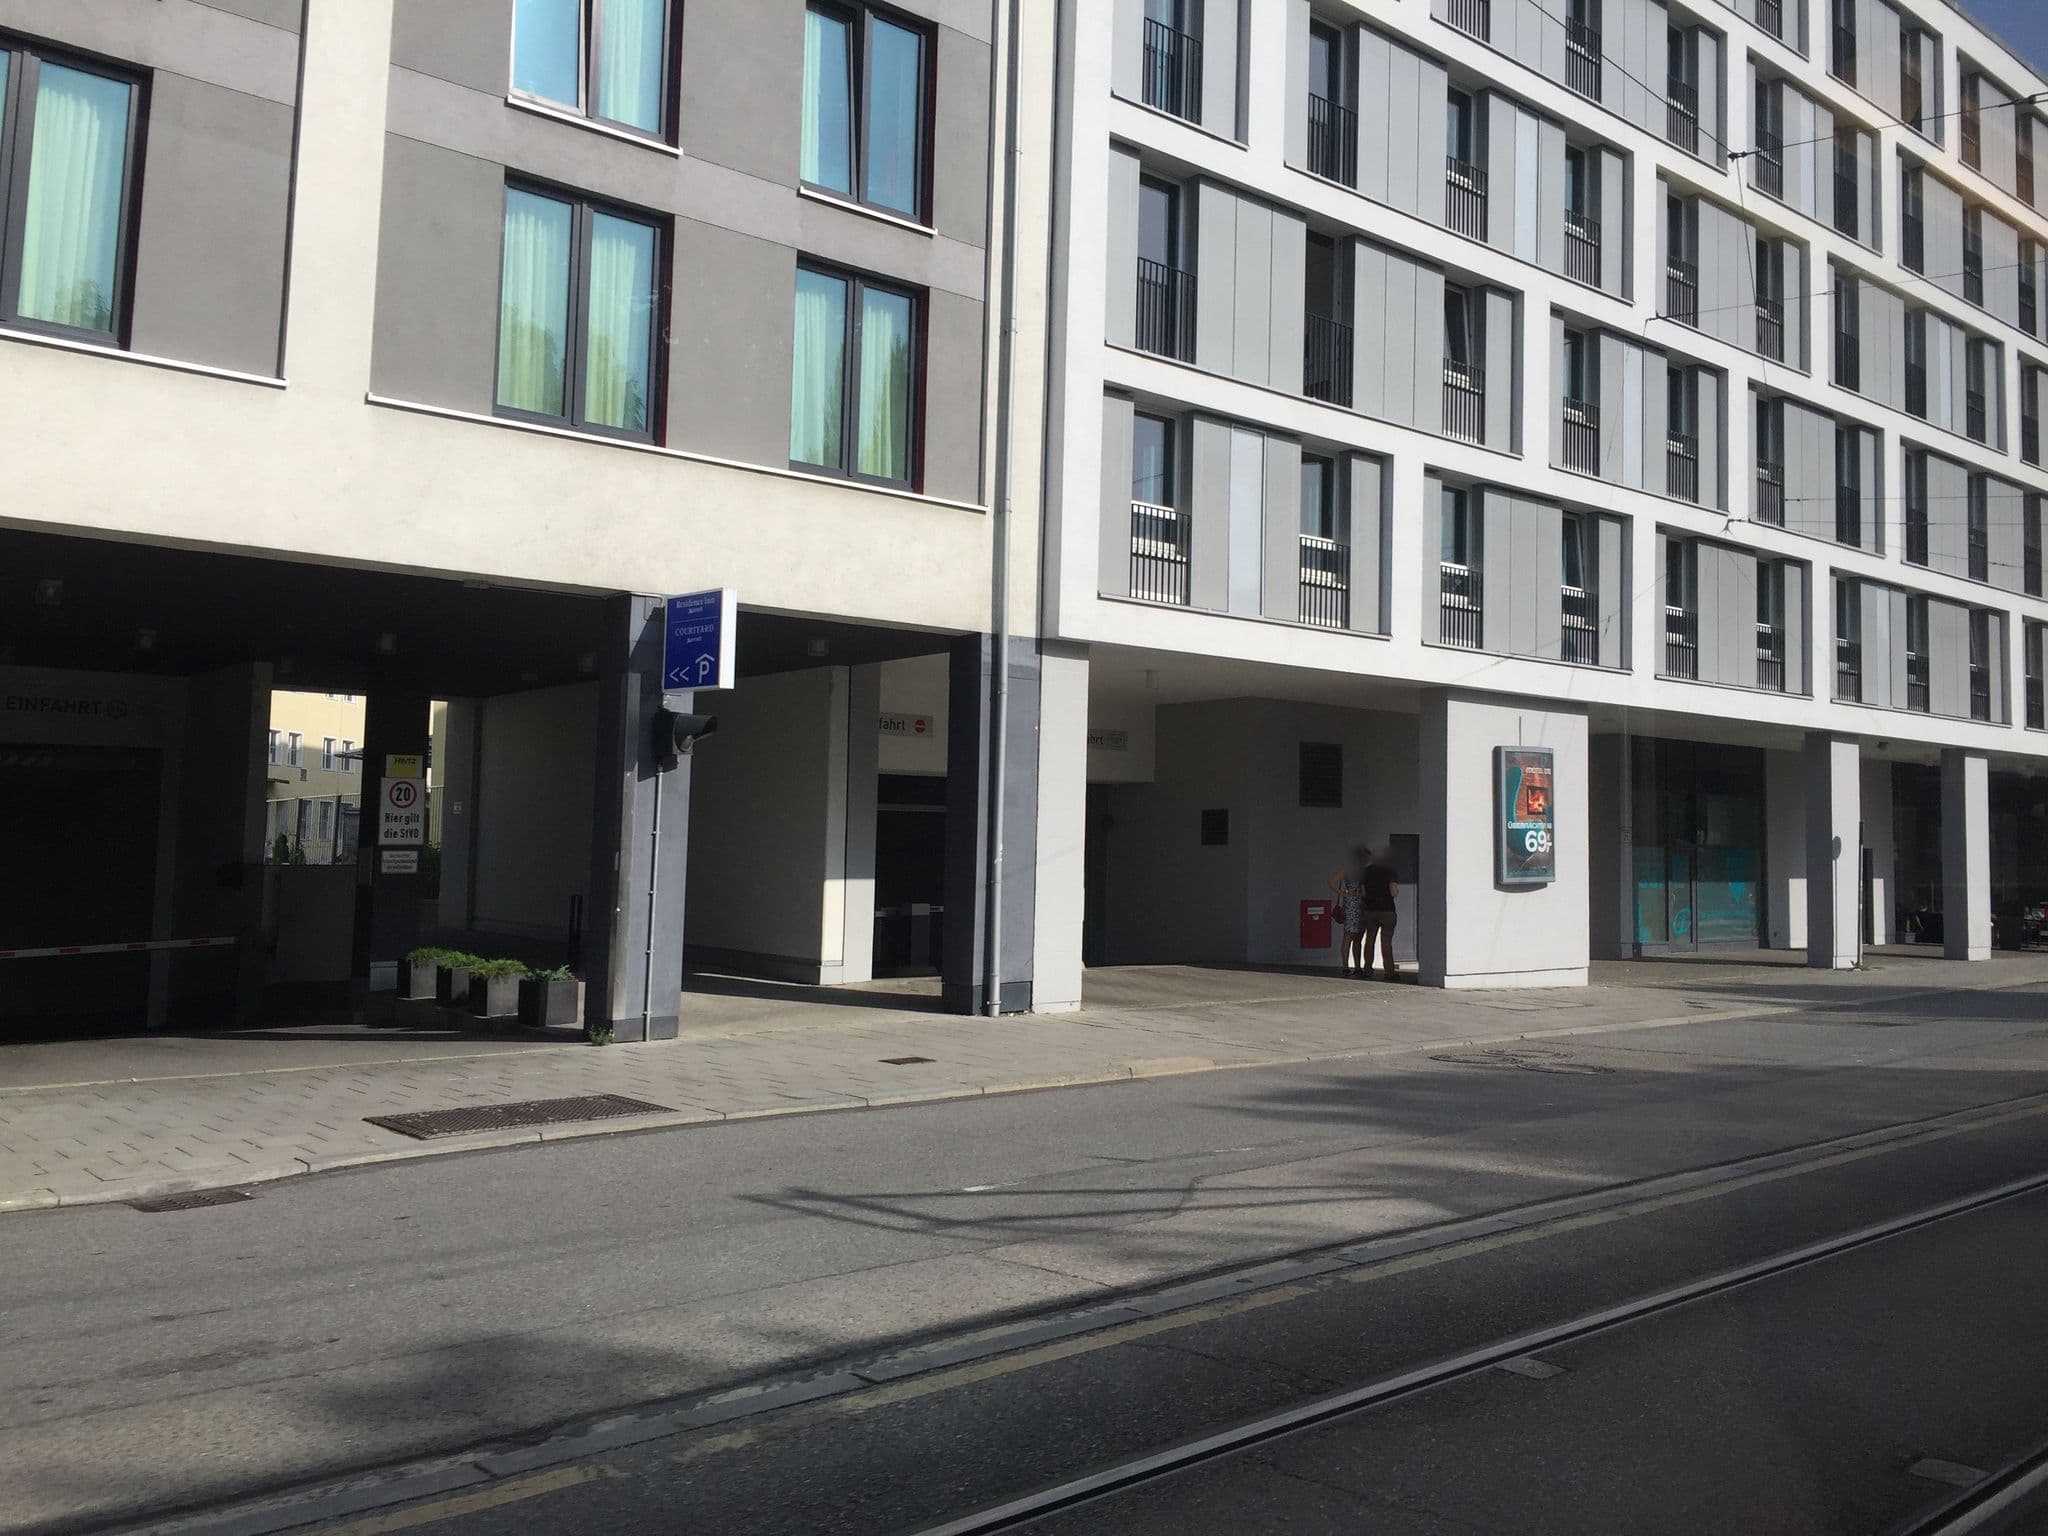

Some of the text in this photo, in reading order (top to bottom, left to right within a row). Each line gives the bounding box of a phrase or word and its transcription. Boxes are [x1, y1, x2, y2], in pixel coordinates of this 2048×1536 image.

[6, 696, 102, 714] EINFAHRT
[395, 787, 411, 802] 20
[384, 813, 420, 826] Hier gilt
[384, 828, 419, 839] die StVO
